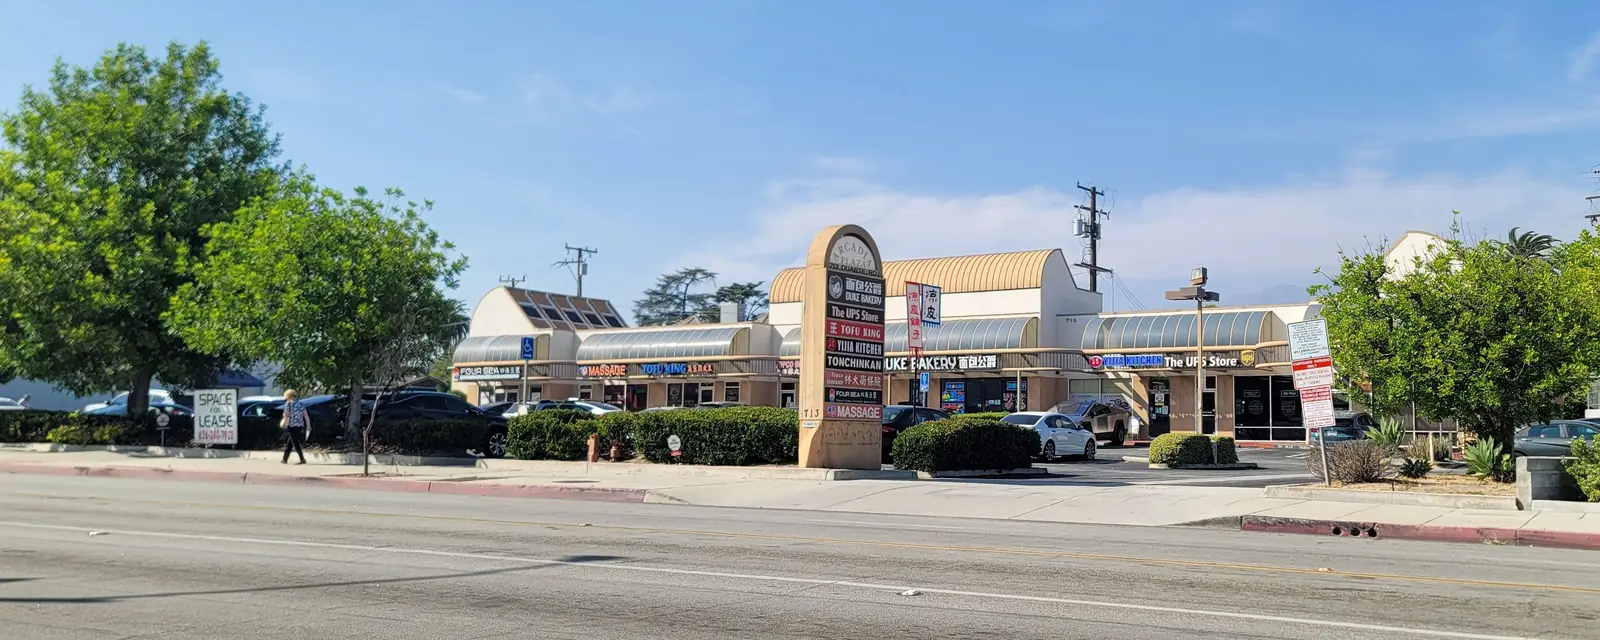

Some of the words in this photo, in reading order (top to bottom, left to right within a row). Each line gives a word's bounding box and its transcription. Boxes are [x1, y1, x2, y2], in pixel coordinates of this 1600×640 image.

[833, 242, 872, 267] ARCADIA
[841, 256, 866, 267] PLAZA
[841, 264, 866, 274] DUARTE
[845, 291, 861, 302] DUKE
[860, 294, 882, 305] BAKERY
[831, 305, 845, 318] The
[845, 307, 861, 320] UPS
[861, 310, 879, 322] Store
[841, 324, 861, 336] TOFU
[863, 327, 881, 339] KING
[837, 339, 854, 352] YIJIA
[855, 341, 882, 355] KITCHEN
[827, 356, 882, 370] TONCHINKAN
[884, 356, 907, 370] UKE
[911, 356, 957, 370] BAKERY
[1126, 354, 1163, 366] KITCHEN
[1164, 356, 1183, 367] The
[1186, 356, 1206, 367] UPS
[1210, 356, 1237, 366] Store
[460, 367, 482, 375] FOUR
[588, 365, 626, 377] MASSAGE
[640, 363, 663, 375] TOFU
[664, 363, 687, 374] KING
[199, 393, 232, 406] SPACE
[835, 390, 850, 398] FOUR
[804, 409, 820, 418] 713
[837, 405, 881, 419] MASSAGE
[198, 415, 234, 428] LEASE
